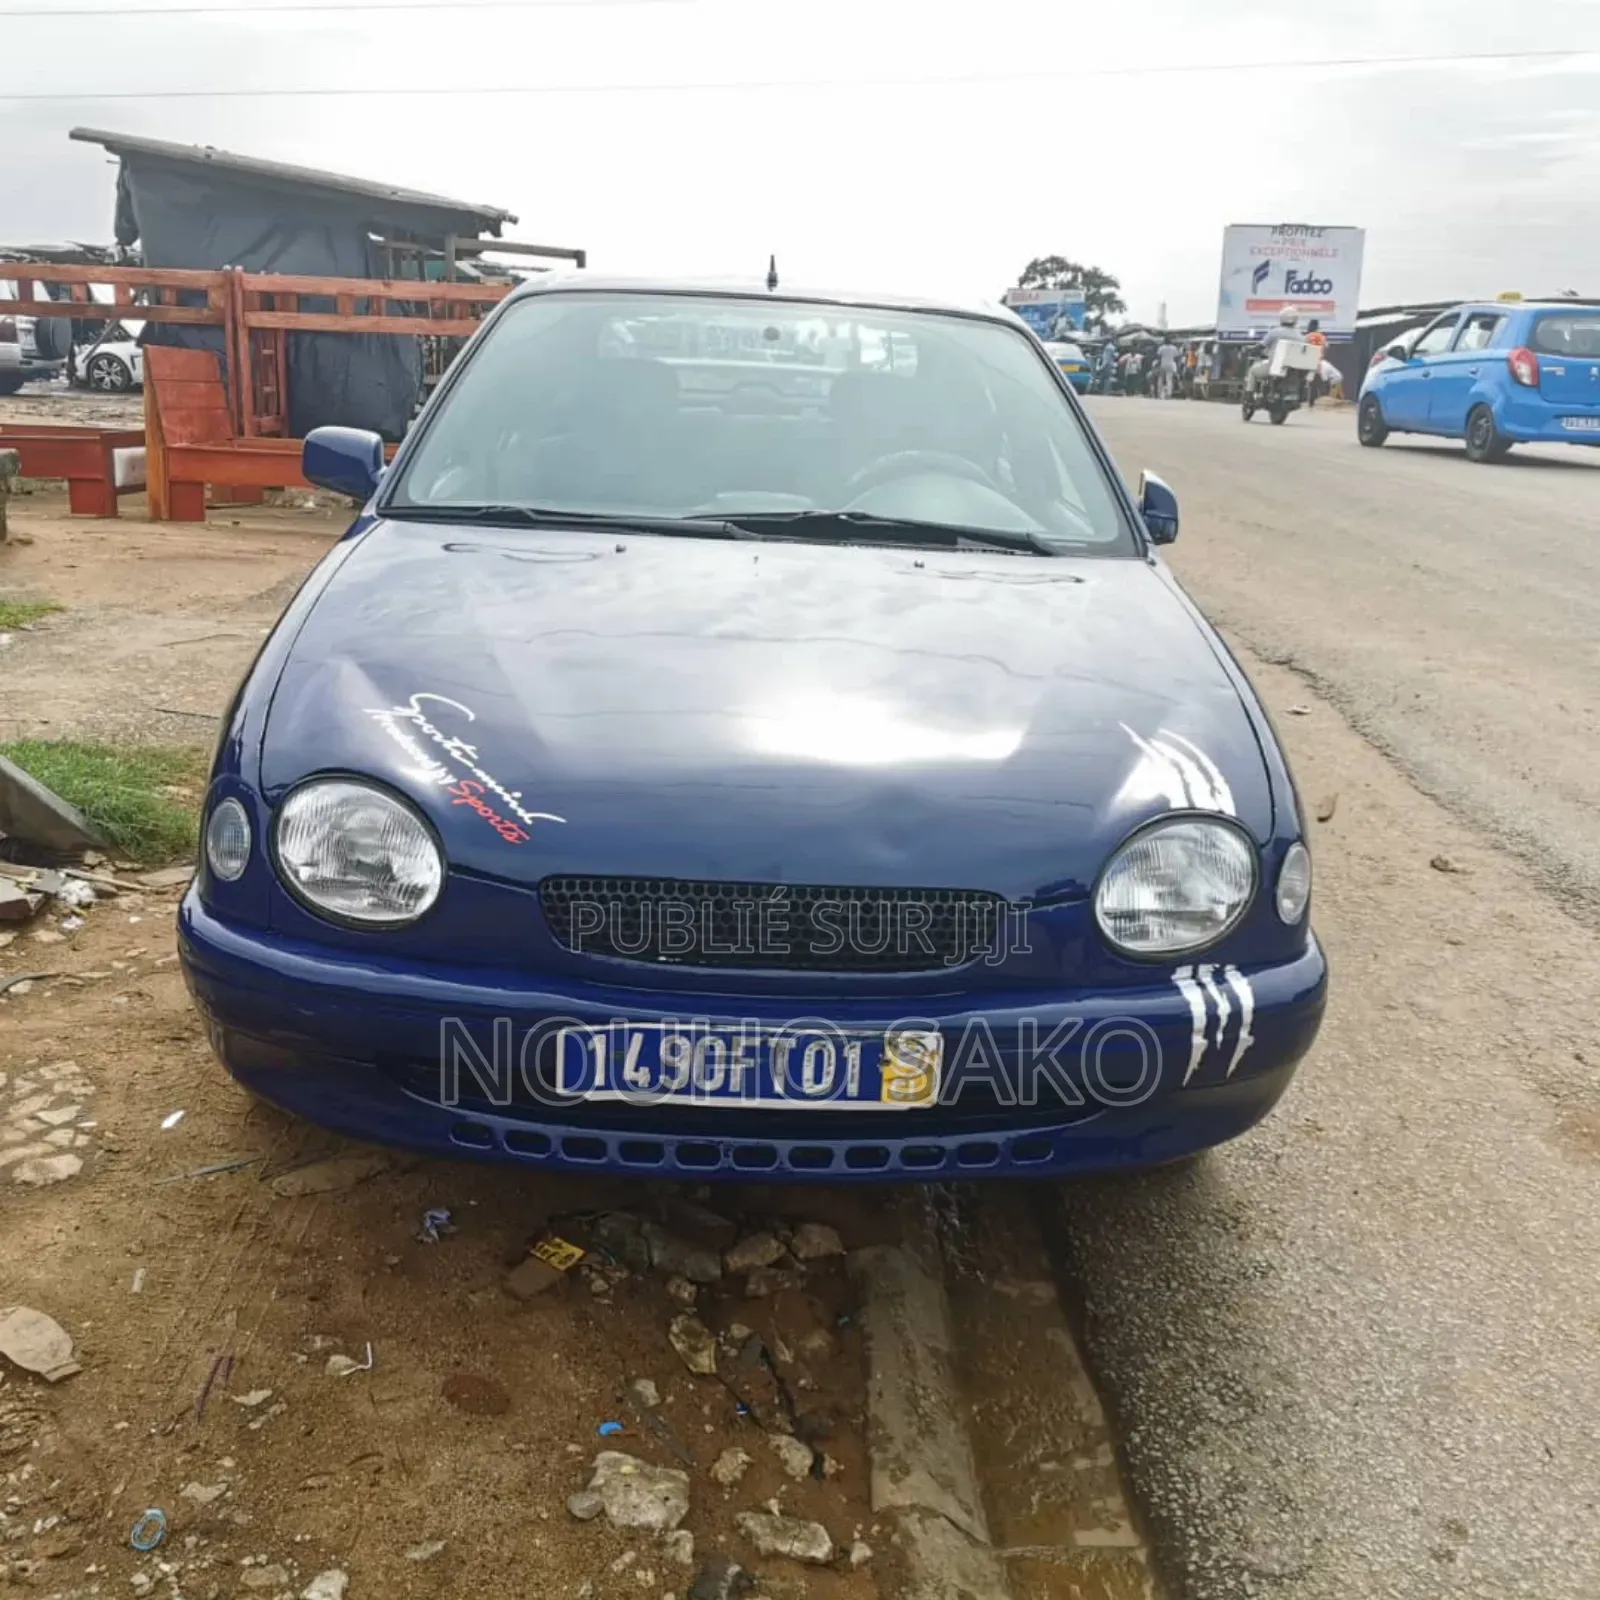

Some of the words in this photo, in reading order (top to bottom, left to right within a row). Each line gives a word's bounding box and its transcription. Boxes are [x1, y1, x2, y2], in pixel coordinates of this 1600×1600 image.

[1271, 225, 1324, 238] PROFITEZ
[1284, 270, 1334, 295] Fadco
[448, 779, 531, 844] Sports
